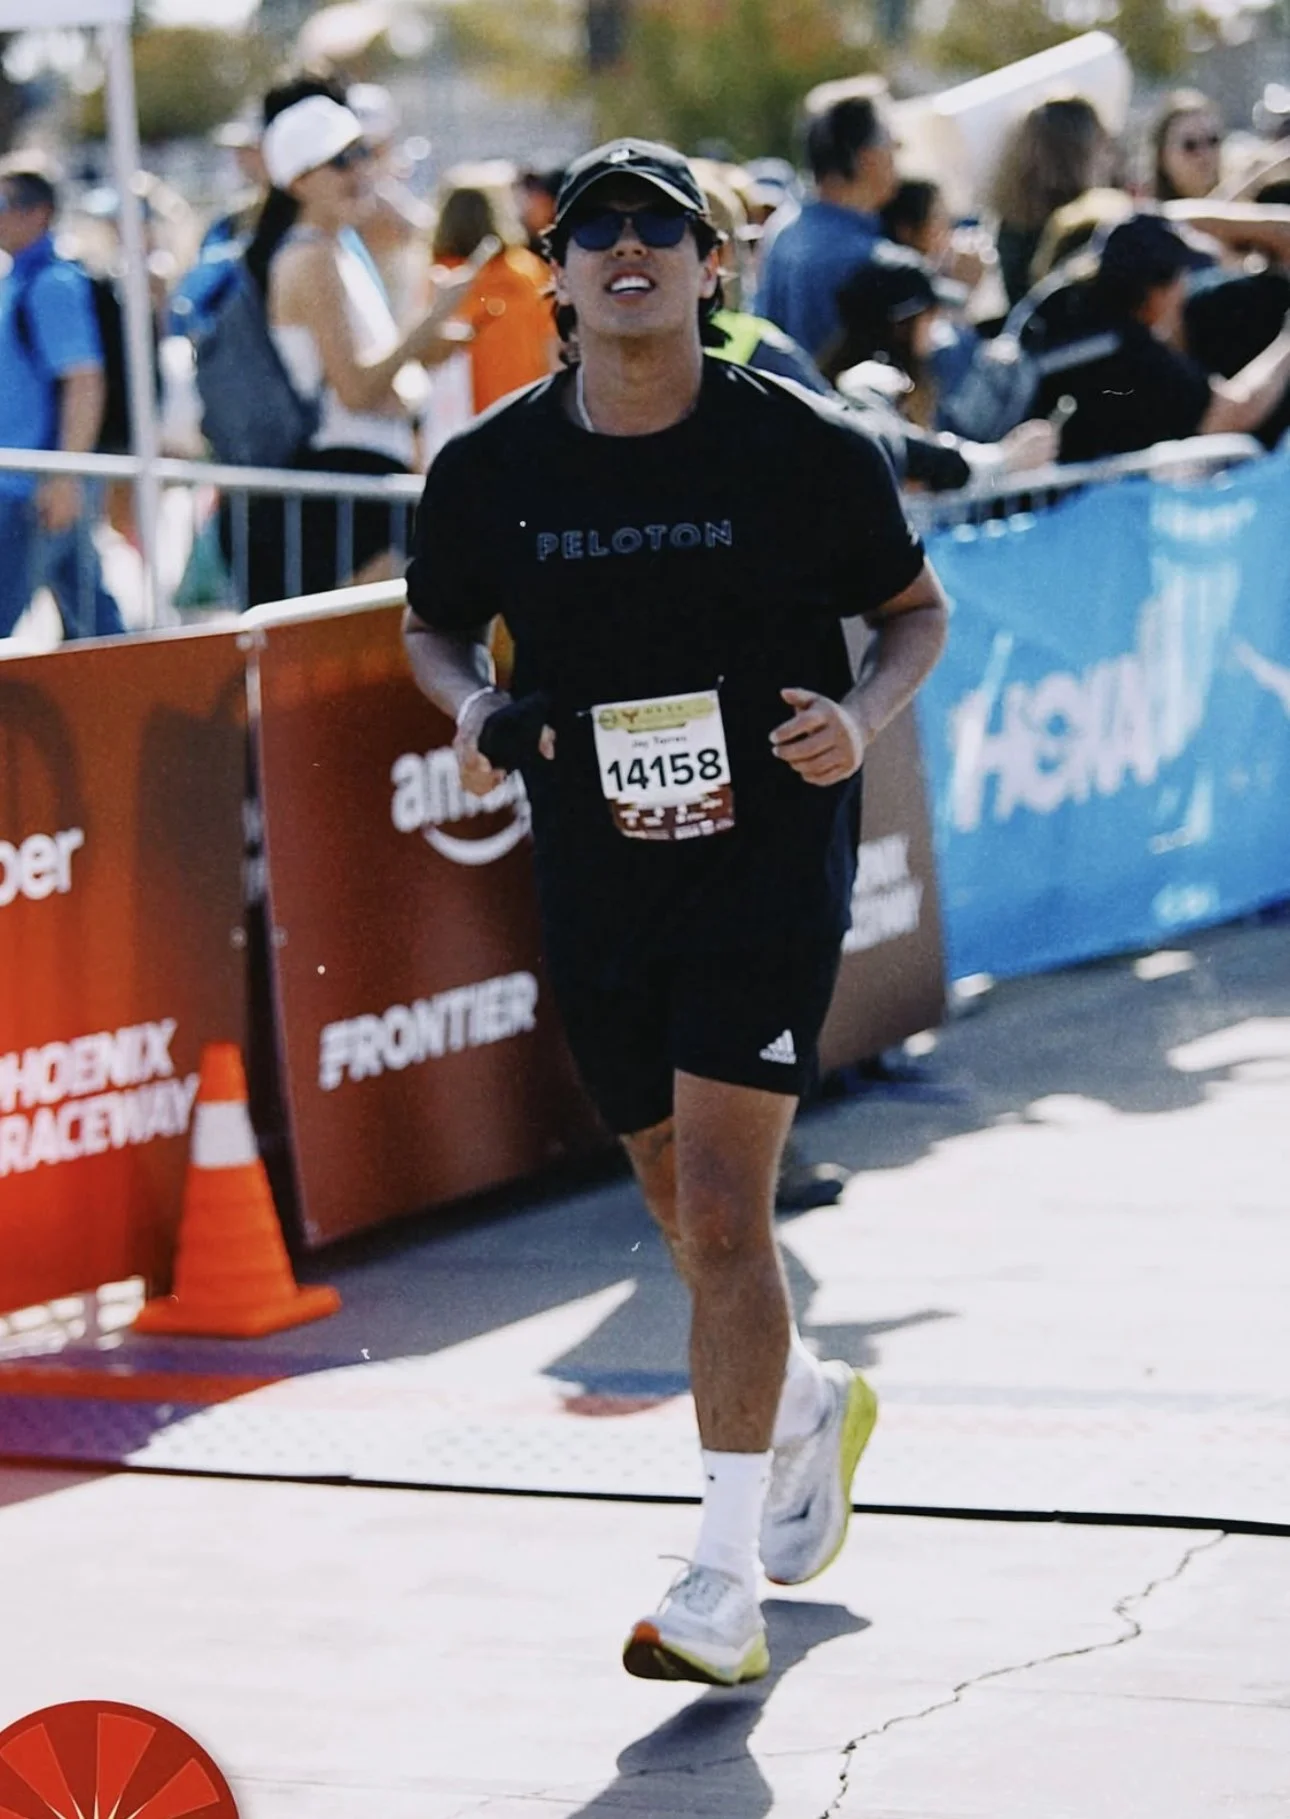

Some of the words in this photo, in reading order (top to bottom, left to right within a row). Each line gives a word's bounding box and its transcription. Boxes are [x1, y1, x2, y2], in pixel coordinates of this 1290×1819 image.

[537, 519, 732, 561] PELOTON
[607, 748, 722, 792] 14158
[318, 971, 539, 1091] FRONTIER
